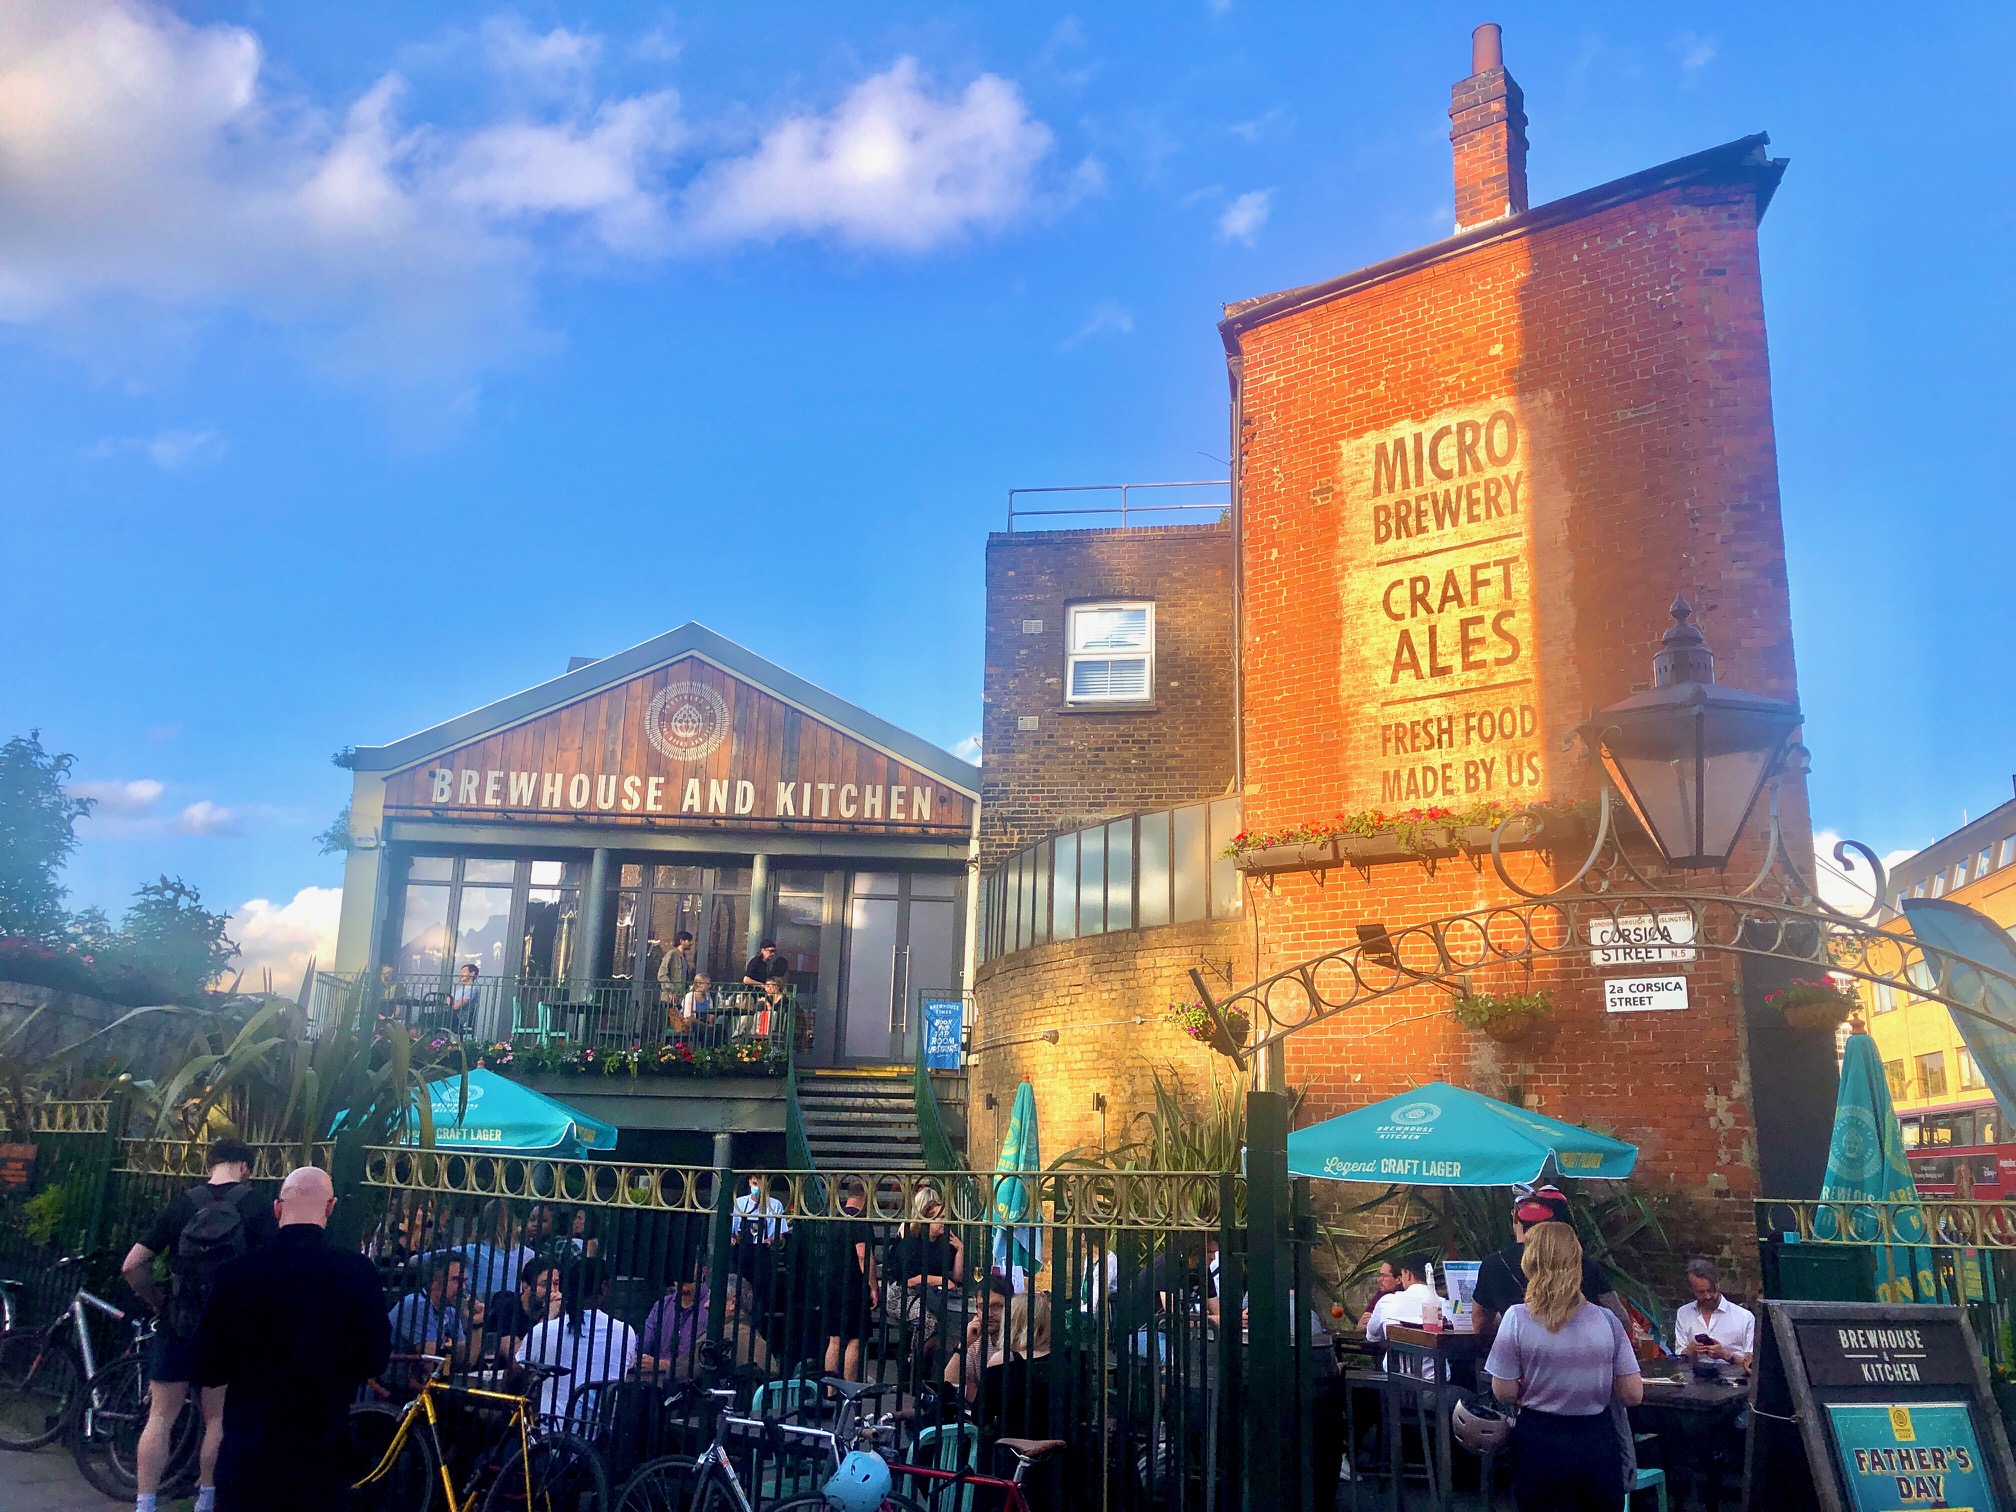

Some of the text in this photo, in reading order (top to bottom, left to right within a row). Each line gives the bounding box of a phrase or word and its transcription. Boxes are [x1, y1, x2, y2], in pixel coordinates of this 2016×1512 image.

[1373, 410, 1518, 498] MICRO
[1374, 471, 1523, 545] BREWERY
[1382, 555, 1520, 622] CRAFT
[1390, 609, 1521, 684] ALES
[1381, 704, 1538, 757] FRESH FOOD
[1381, 750, 1541, 804] MADE BY US
[431, 768, 932, 821] BREWHOUSE AND KITCHEN
[1600, 925, 1673, 944] CORSICA
[1601, 947, 1686, 963] STREET N.5
[1608, 981, 1683, 994] 2a CORSICA
[1609, 996, 1654, 1007] STREET
[931, 1037, 955, 1045] ROOM
[436, 1127, 502, 1142] CRAFT LAGER
[1376, 1125, 1435, 1133] BREWHOUSE
[1323, 1156, 1461, 1178] Legend CRAFT LAGER
[1838, 1329, 1924, 1349] BREWHOUSE
[1860, 1363, 1921, 1382] KITCHEN
[1894, 1474, 1946, 1503] DAY
